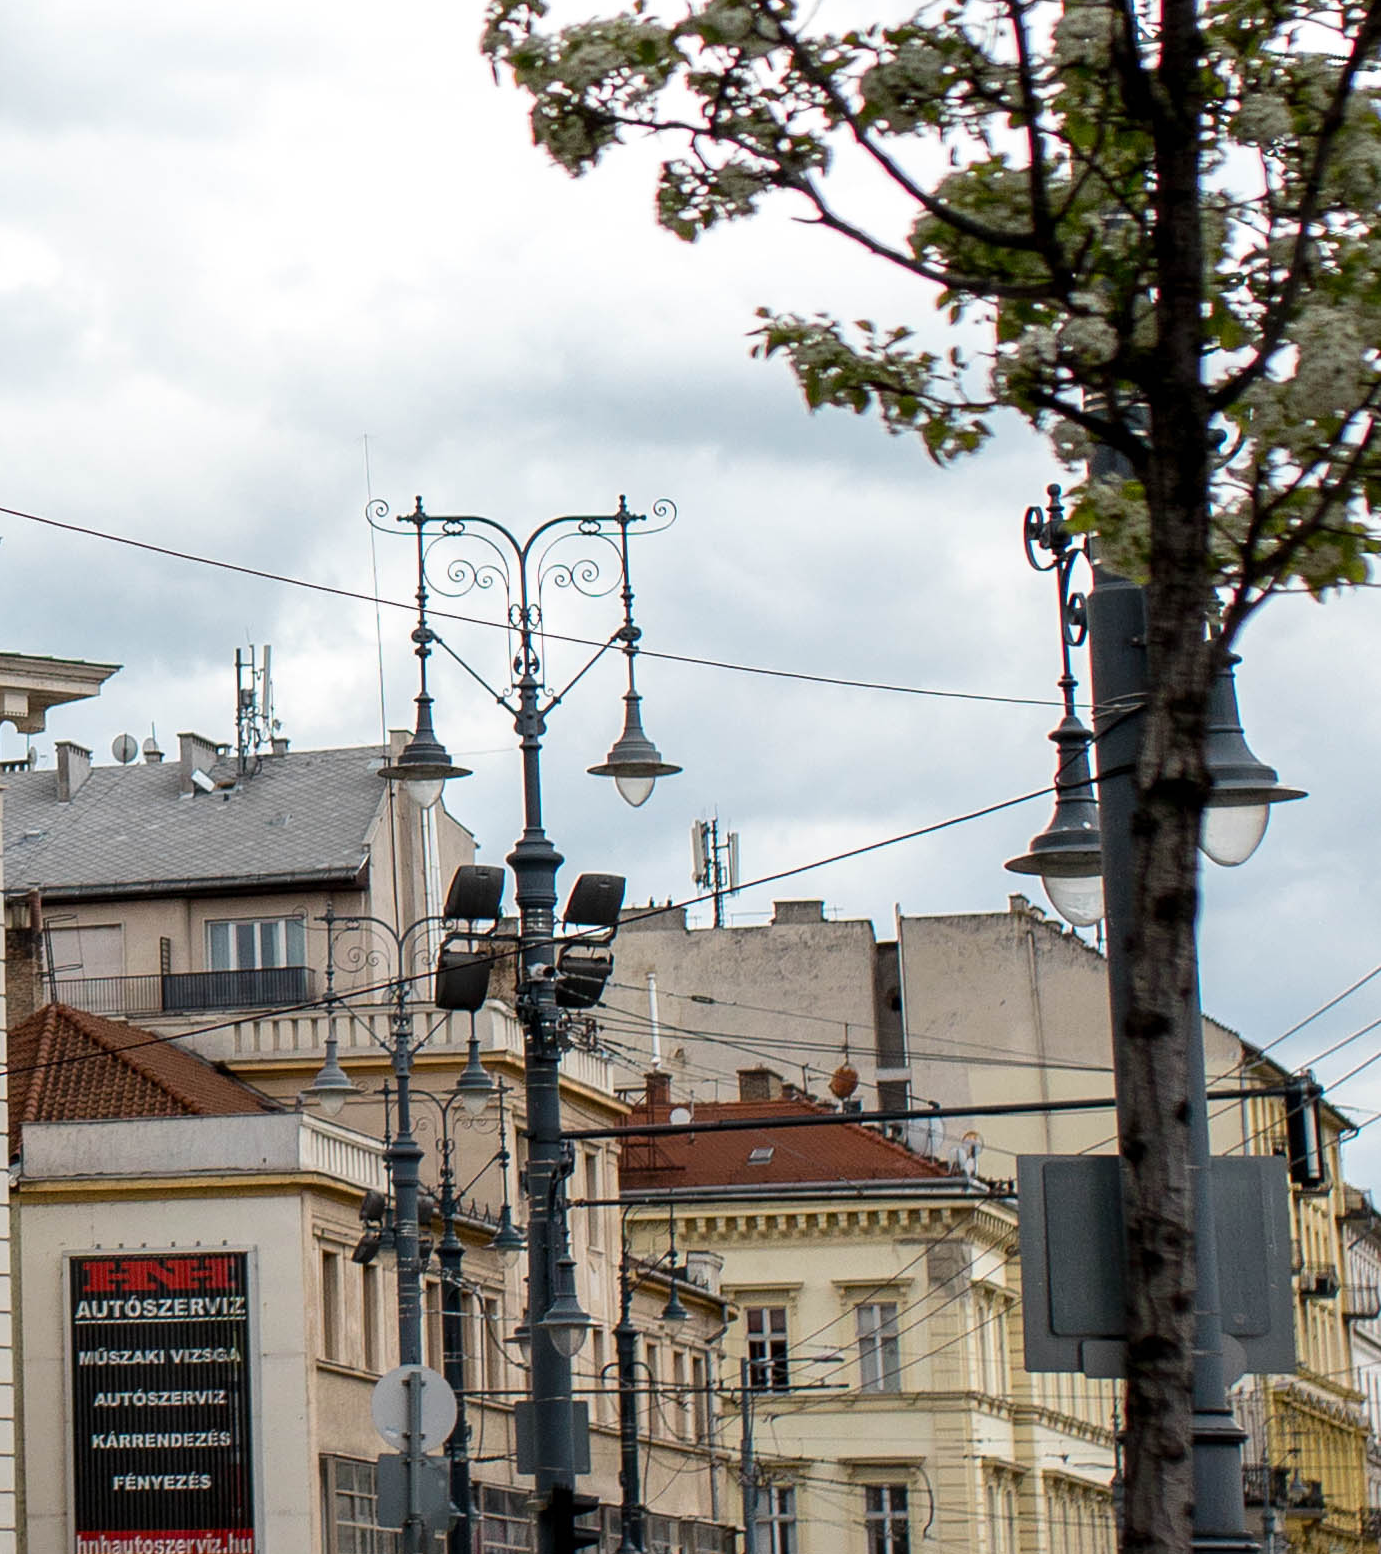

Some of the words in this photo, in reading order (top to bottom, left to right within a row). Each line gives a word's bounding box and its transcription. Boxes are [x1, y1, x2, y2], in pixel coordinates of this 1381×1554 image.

[75, 1295, 247, 1319] AUTÓSZERVIZ
[78, 1347, 165, 1366] MŰSZAKI
[170, 1347, 241, 1365] VIZSGA
[93, 1388, 228, 1407] AUTÓSZERVIZ
[91, 1429, 232, 1449] KÁRRENDEZÉS
[112, 1471, 213, 1491] FÉNYEZÉS
